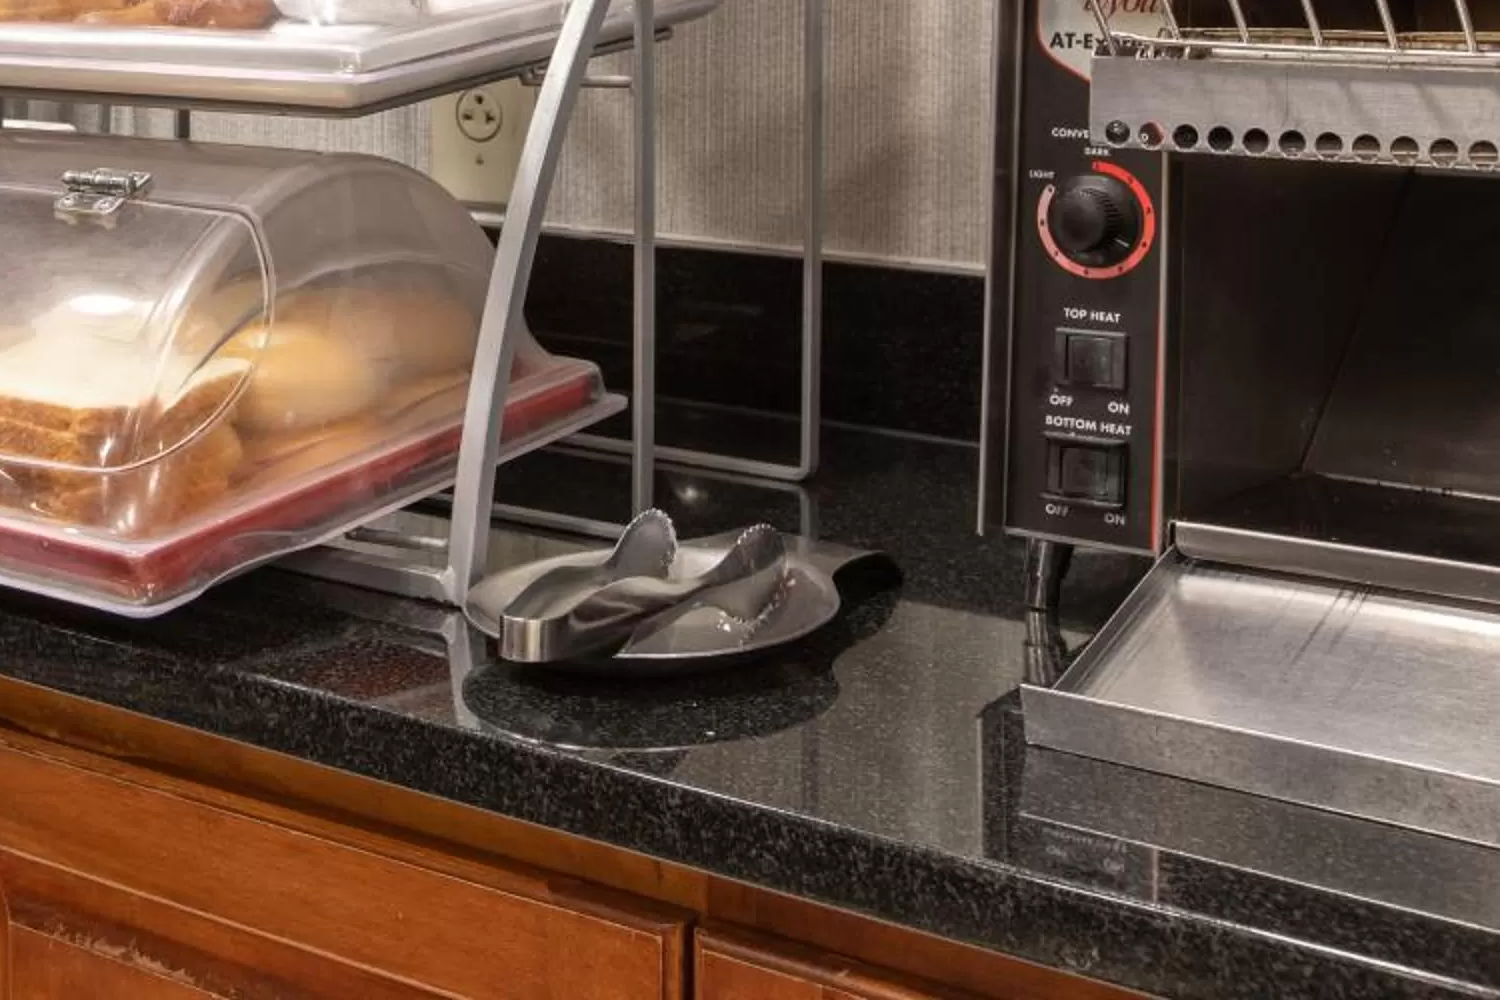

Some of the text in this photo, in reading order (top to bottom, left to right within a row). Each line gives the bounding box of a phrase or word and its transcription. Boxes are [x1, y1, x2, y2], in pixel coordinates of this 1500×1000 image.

[1051, 127, 1091, 139] CONVE
[1083, 147, 1111, 157] DARK
[1029, 169, 1056, 180] LIGHT
[1063, 306, 1122, 324] TOP HEAT
[1049, 393, 1131, 416] OFF ON
[1044, 414, 1133, 436] BOTTOM HEAT
[1044, 503, 1126, 526] OFF ON
